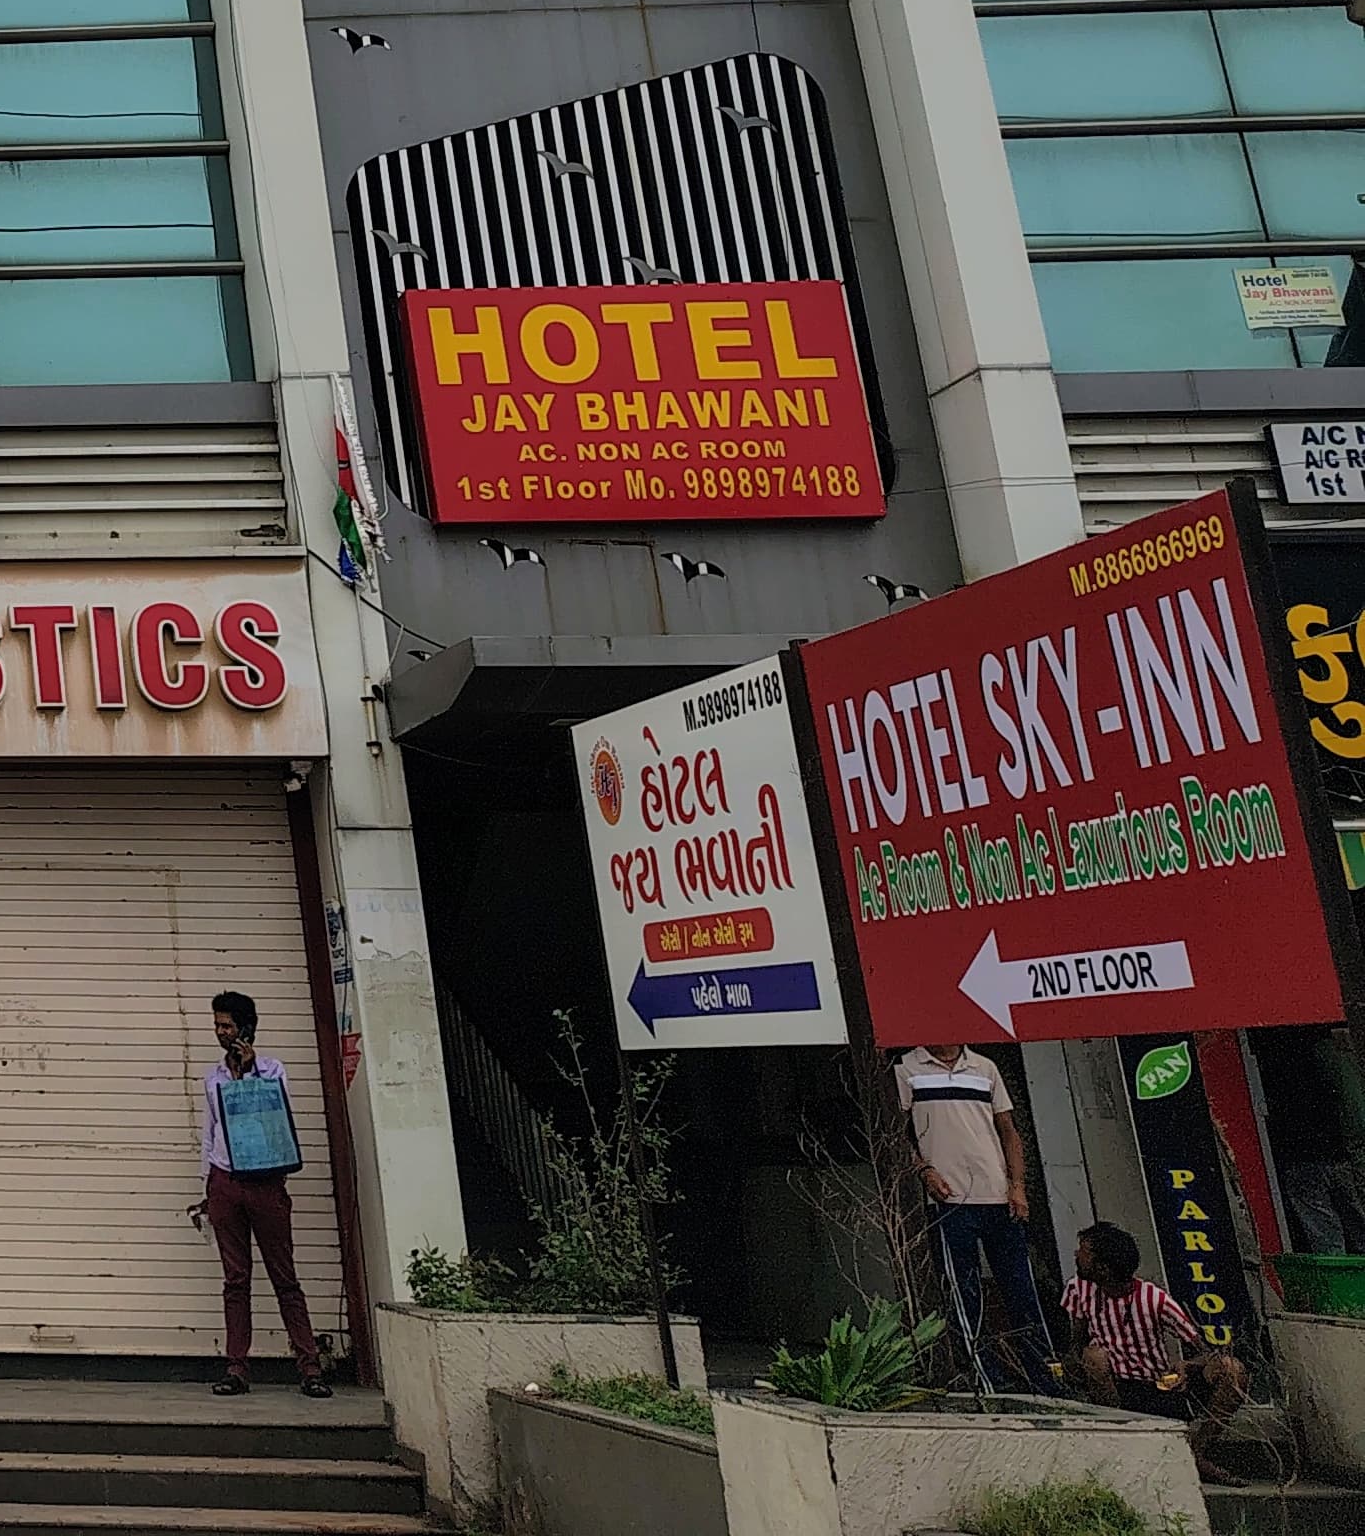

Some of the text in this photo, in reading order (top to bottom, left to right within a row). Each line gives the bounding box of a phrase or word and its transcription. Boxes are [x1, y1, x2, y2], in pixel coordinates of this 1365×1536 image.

[1241, 274, 1288, 288] Hotel
[1243, 285, 1334, 301] Jay Bhawani
[427, 299, 839, 386] HOTEL
[461, 388, 831, 434] JAY BHAWANI
[519, 439, 786, 463] AC. NON AC ROOM
[1301, 425, 1346, 446] A/C
[1304, 448, 1341, 470] A/C
[457, 465, 861, 502] 1st Floor Mo. 9898974188
[1305, 471, 1348, 497] 1st
[1069, 515, 1226, 598] M.8866866969
[682, 670, 784, 732] M.9898974188
[826, 577, 1262, 834] HOTEL SKY-INN
[640, 725, 732, 833] હોટલ
[610, 783, 796, 914] જય ભવાની
[854, 846, 887, 922] Ac
[880, 840, 950, 918] Room
[945, 827, 971, 908] &
[962, 822, 1021, 906] Non
[1015, 812, 1056, 899] Ac
[1179, 774, 1287, 870] Room
[1028, 952, 1159, 998] 2ND FLOOR
[1140, 1052, 1188, 1092] PAN
[1169, 1169, 1232, 1346] PARLOU
